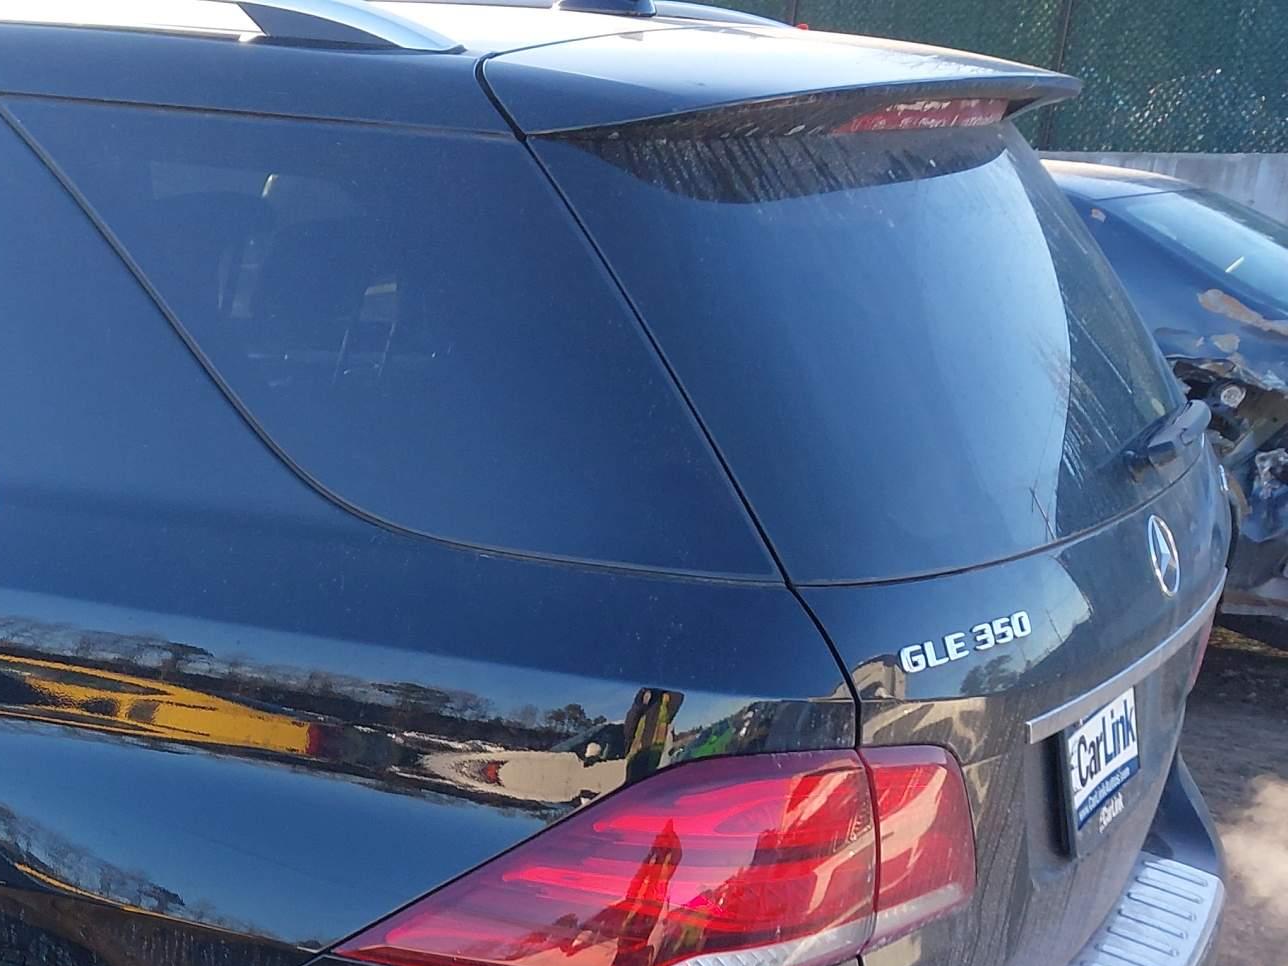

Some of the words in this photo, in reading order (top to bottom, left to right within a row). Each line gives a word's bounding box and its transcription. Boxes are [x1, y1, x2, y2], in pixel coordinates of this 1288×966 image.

[900, 632, 970, 673] GLE
[970, 610, 1032, 650] 350
[1077, 699, 1136, 788] CarLink
